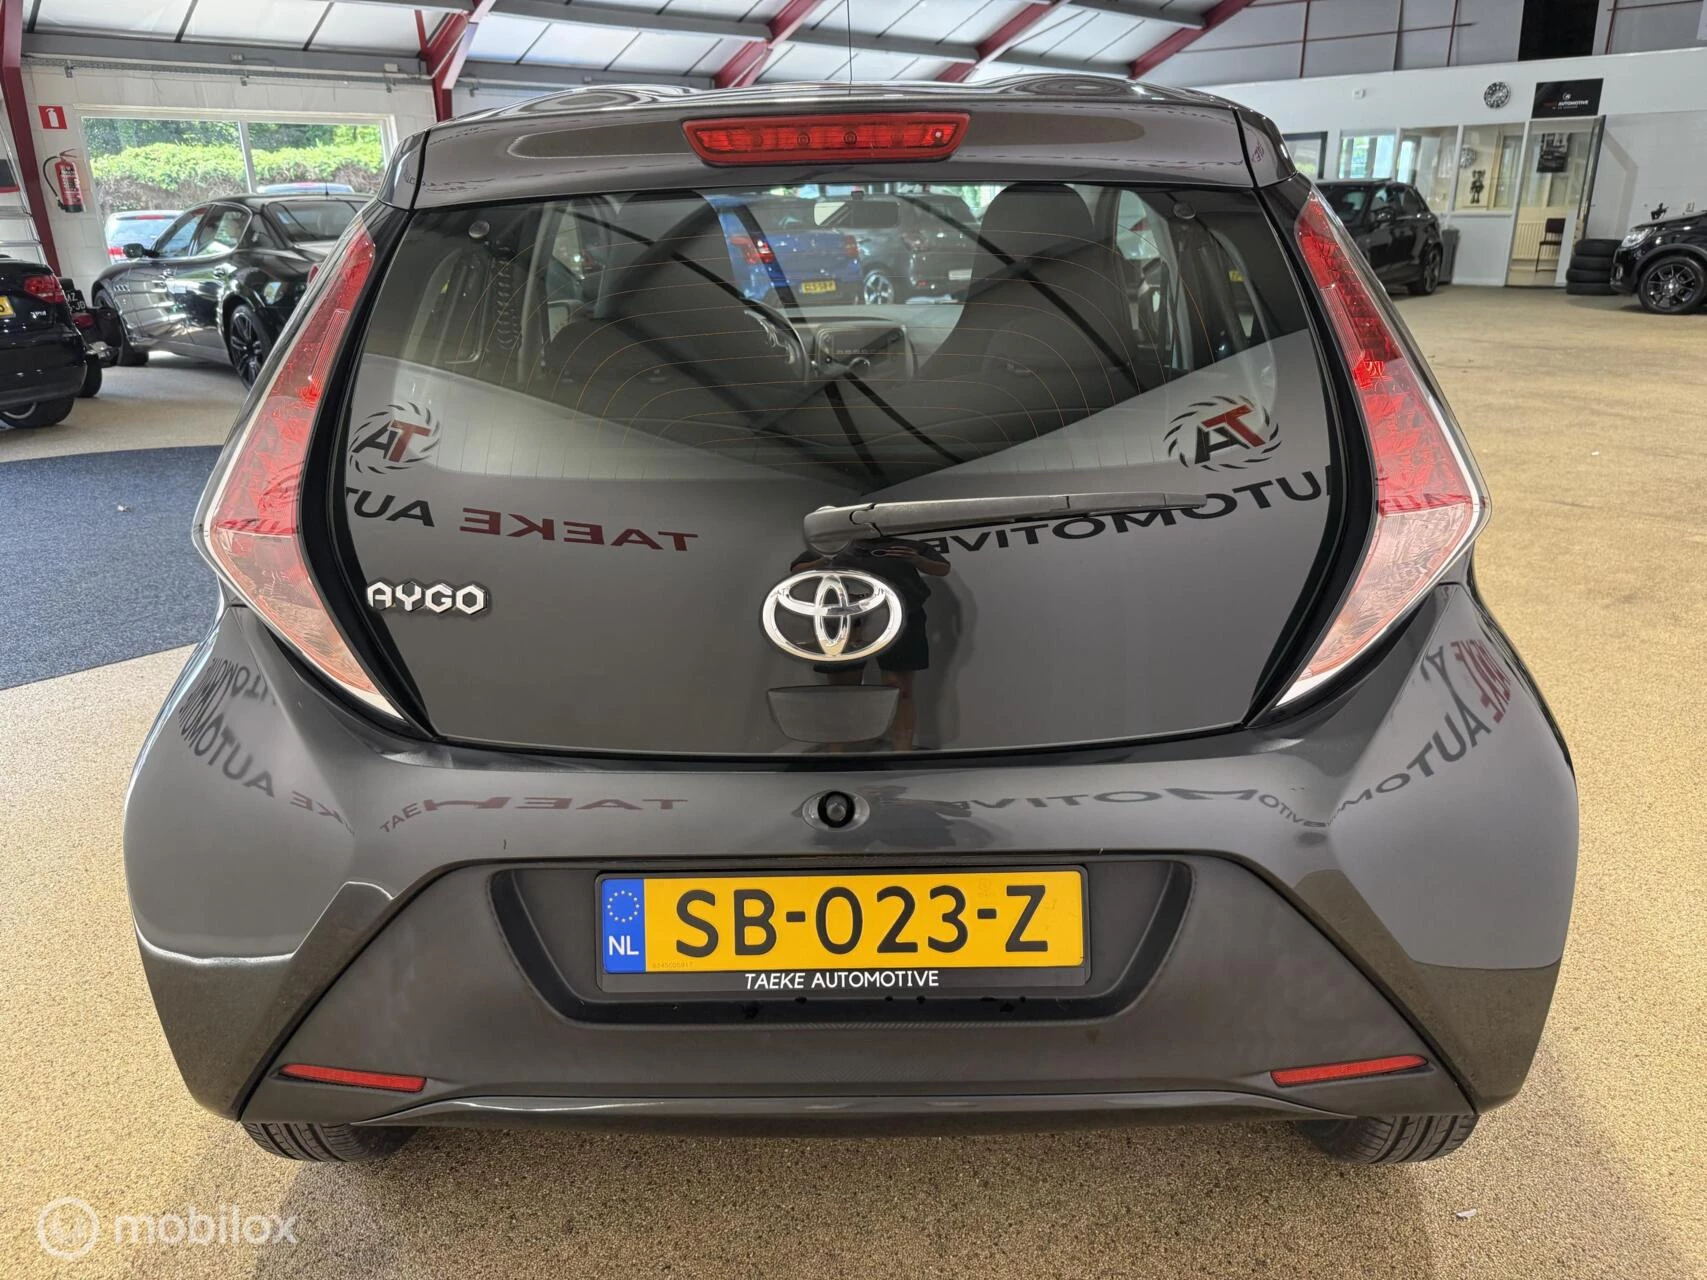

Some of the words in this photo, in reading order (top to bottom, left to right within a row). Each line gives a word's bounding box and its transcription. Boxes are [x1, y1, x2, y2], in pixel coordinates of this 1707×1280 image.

[366, 580, 489, 616] AYGO
[675, 884, 1049, 959] SB-023-Z
[608, 934, 640, 957] NL
[744, 972, 806, 990] TAEKE
[810, 970, 940, 989] AUTOMOTIVE
